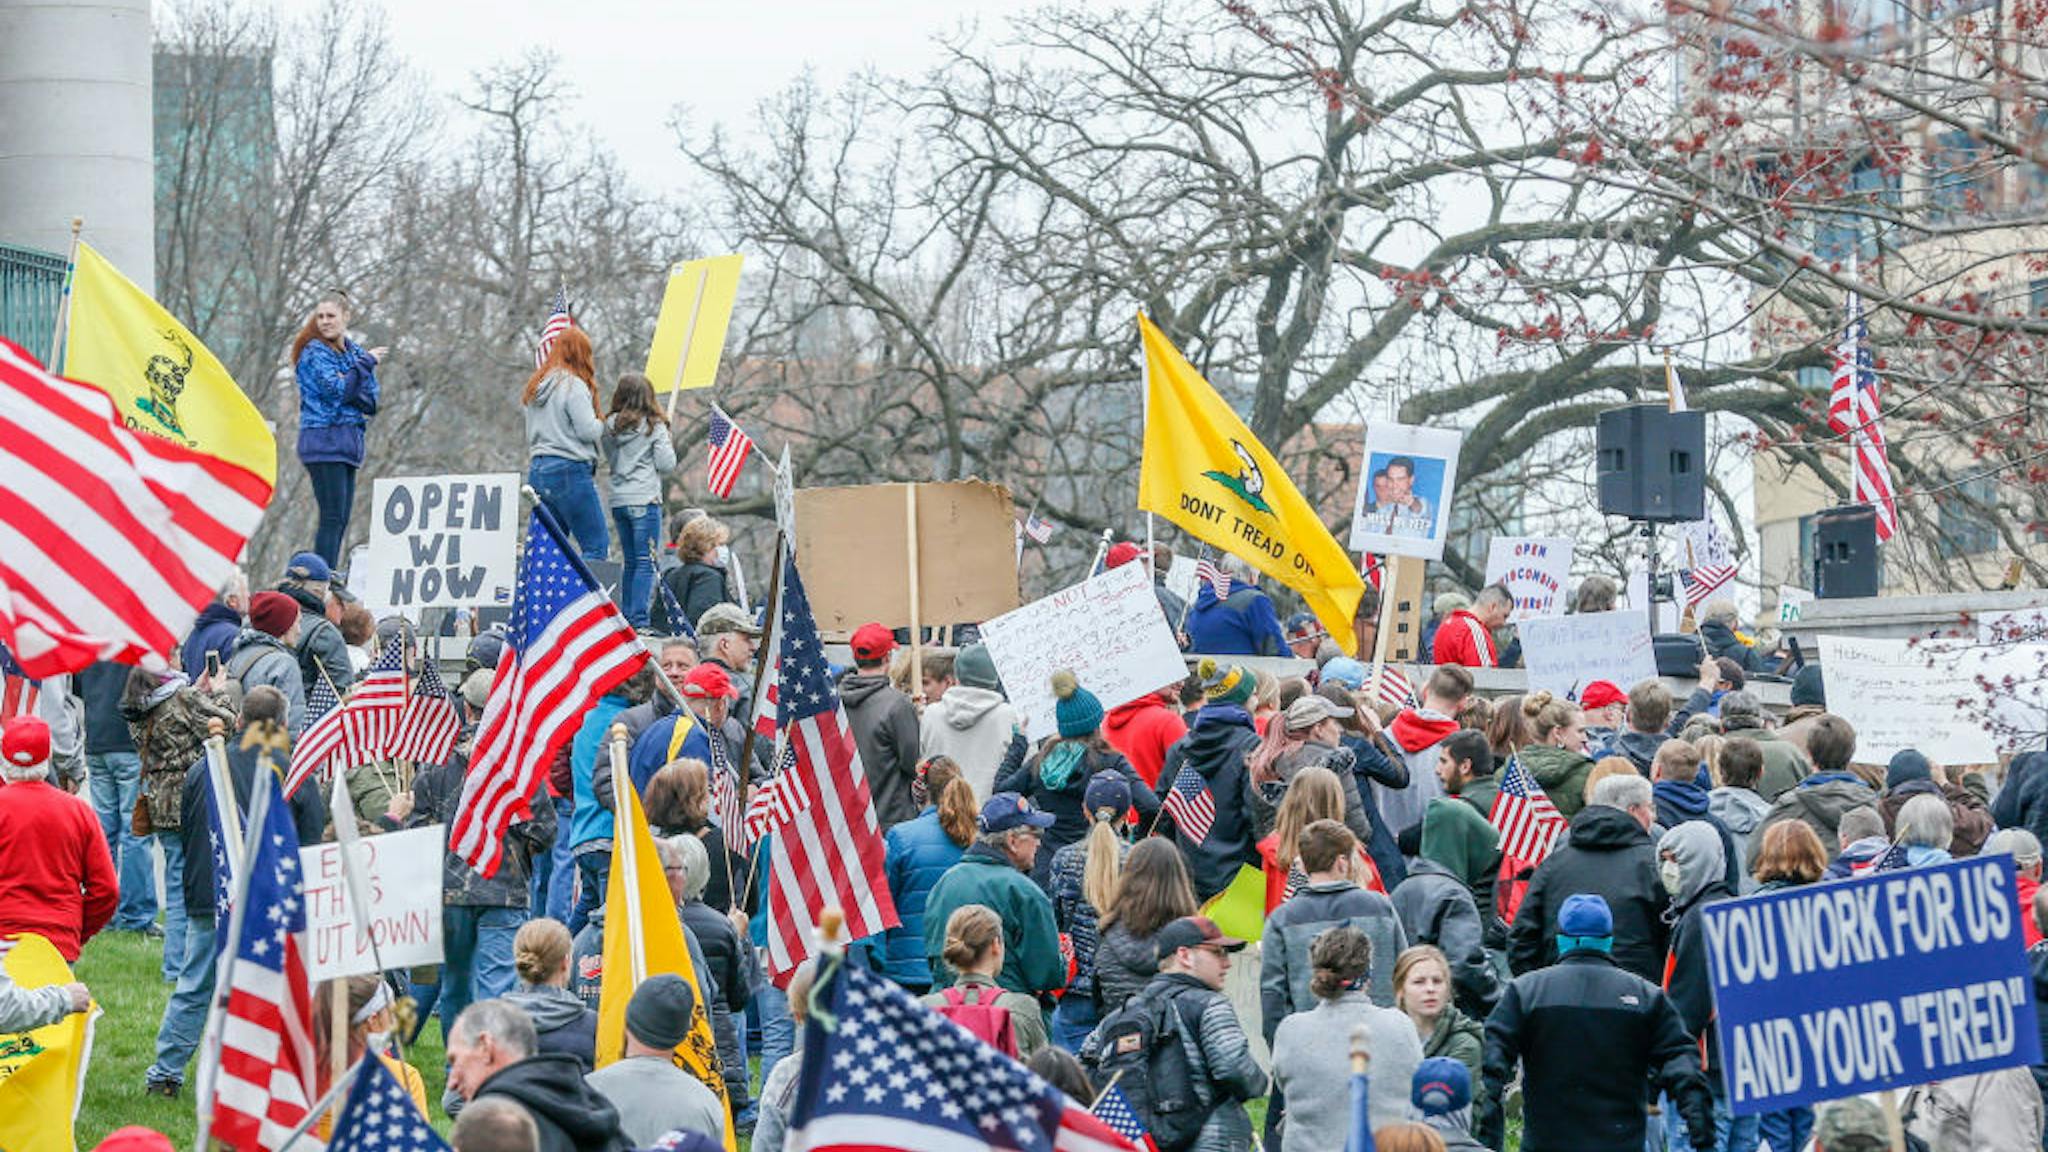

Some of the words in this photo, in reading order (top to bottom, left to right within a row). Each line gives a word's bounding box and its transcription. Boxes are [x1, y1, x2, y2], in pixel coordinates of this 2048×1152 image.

[384, 482, 502, 535] OPEN
[1181, 493, 1226, 525] DONT
[1233, 516, 1285, 559] TREAD
[408, 532, 460, 567] WI
[1515, 542, 1547, 559] OPEN
[390, 566, 487, 606] NOW
[1052, 584, 1090, 610] NOT
[304, 875, 383, 917] THS
[1705, 903, 1780, 986] YOU
[1779, 884, 1889, 974] WORK
[1885, 871, 1963, 956] FOR
[1960, 862, 2012, 944] US
[1733, 1018, 1802, 1102] AND
[1801, 1001, 1904, 1088] YOUR
[1901, 976, 2027, 1069] "FIRED"
